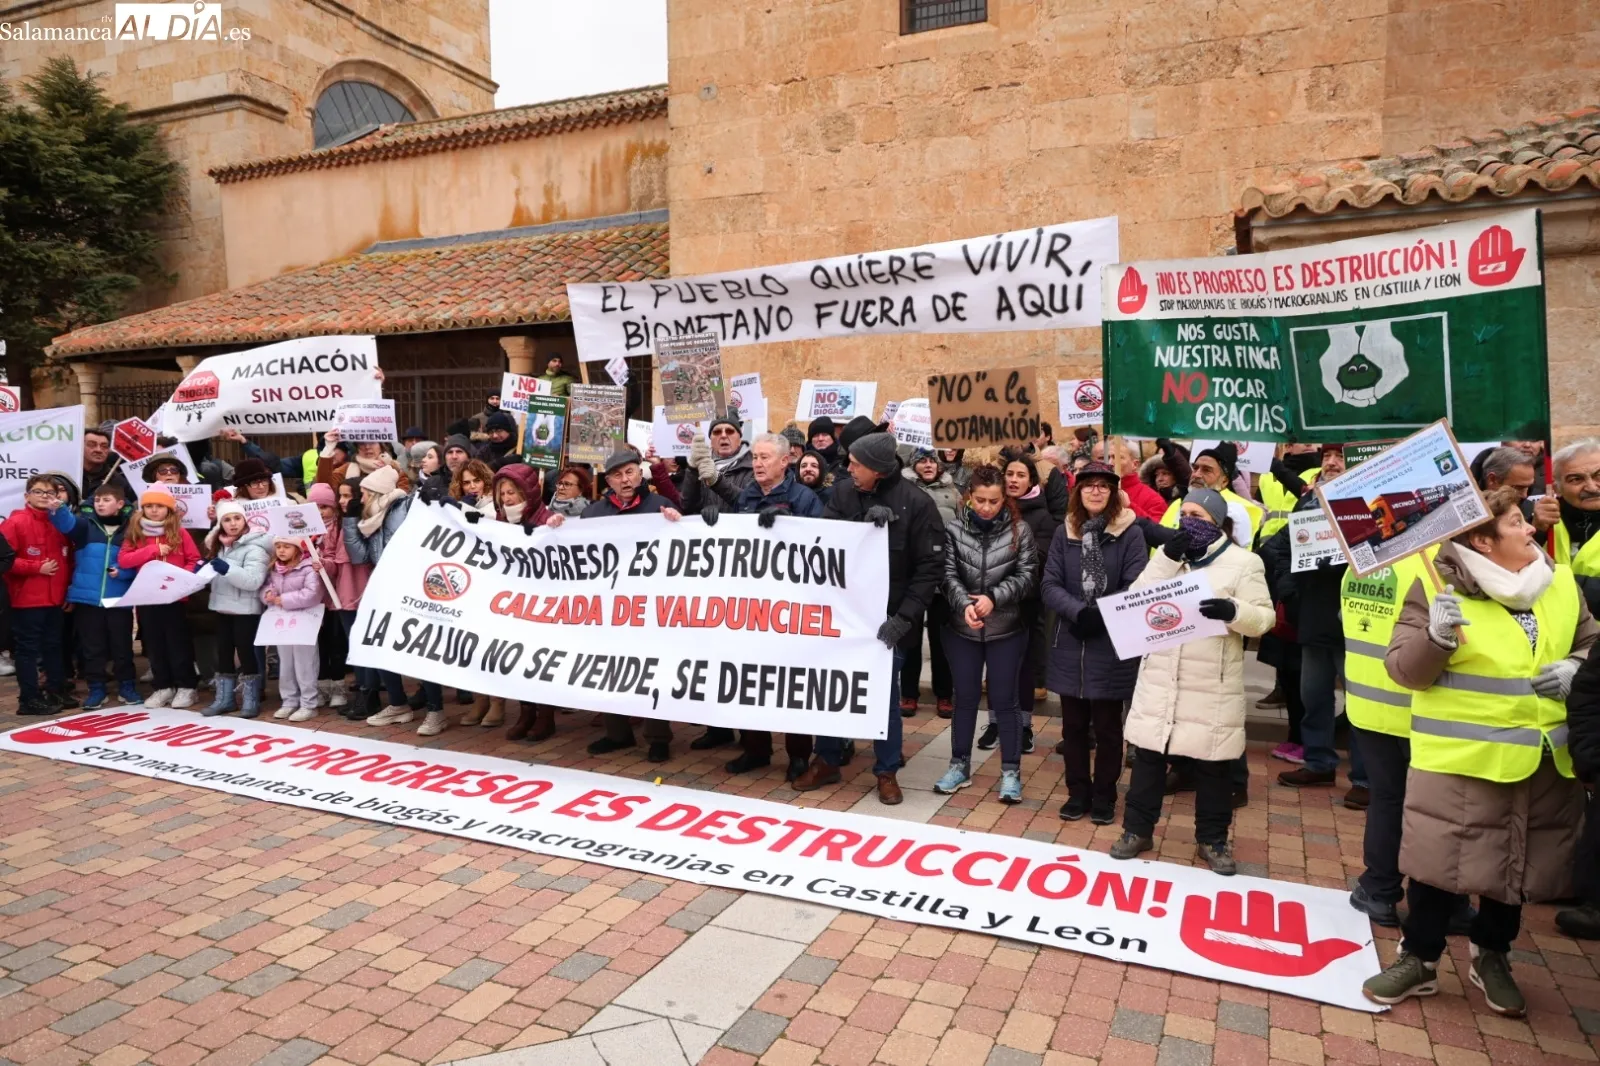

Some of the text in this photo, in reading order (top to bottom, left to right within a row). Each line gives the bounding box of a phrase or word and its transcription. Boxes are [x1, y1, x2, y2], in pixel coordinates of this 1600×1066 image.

[601, 285, 634, 313] EL
[650, 274, 788, 309] PUEBLO
[810, 252, 936, 291] QUIERE
[1179, 271, 1192, 295] ES
[1273, 264, 1295, 292] ES
[1160, 299, 1175, 312] STOP
[1177, 298, 1225, 311] MACROPLANTAS
[1228, 299, 1237, 310] DE
[1240, 294, 1266, 310] BIOGÁS
[1267, 299, 1273, 309] Y
[1274, 290, 1348, 310] MACROGRANJAS
[1355, 286, 1370, 300] EN
[1373, 278, 1421, 298] CASTILLA
[1424, 276, 1432, 290] Y
[622, 304, 793, 351] BIOMETANO
[814, 296, 917, 329] FUERA
[932, 292, 968, 322] DE
[1177, 322, 1260, 342] NOS GUSTA
[232, 348, 368, 381] MACHACÓN
[1154, 345, 1281, 370] NUESTRA FINCA
[181, 376, 213, 388] STOP
[251, 384, 344, 403] SIN OLOR
[984, 386, 998, 403] a
[1005, 370, 1031, 405] la
[1162, 371, 1268, 404] NO TOCAR
[815, 392, 837, 403] NO
[131, 420, 153, 437] STOP
[223, 414, 242, 426] NI
[245, 409, 335, 425] CONTAMINA
[1195, 403, 1287, 433] GRACIAS
[906, 434, 931, 445] DEFIE
[1357, 445, 1394, 453] TORNADI
[1392, 499, 1415, 509] VECINOS
[1337, 513, 1372, 521] ALDEATEJADA
[421, 524, 846, 589] NO ES PROGRESO, ES DESTRUCCIÓN
[1298, 558, 1311, 569] SE
[1116, 584, 1200, 612] DE NUESTROS HIJOS
[1124, 580, 1183, 601] POR LA SALUD
[1347, 581, 1393, 600] BIOGÁS
[490, 590, 603, 625] CALZADA
[611, 595, 647, 626] DE
[656, 596, 841, 637] VALDUNCIEL
[1145, 632, 1165, 642] STOP
[1166, 624, 1196, 637] BIOGAS
[362, 609, 869, 714] LA SALUD NO SE VENDE, SE DEFIENDE
[200, 734, 295, 758] ES
[259, 743, 553, 813] PROGRESO,
[551, 789, 651, 822] ES
[636, 803, 1173, 918] DESTRUCCIÓN!
[70, 745, 1149, 953] STOP macroplantas de biogás y macrogranjas en Castilla y León
